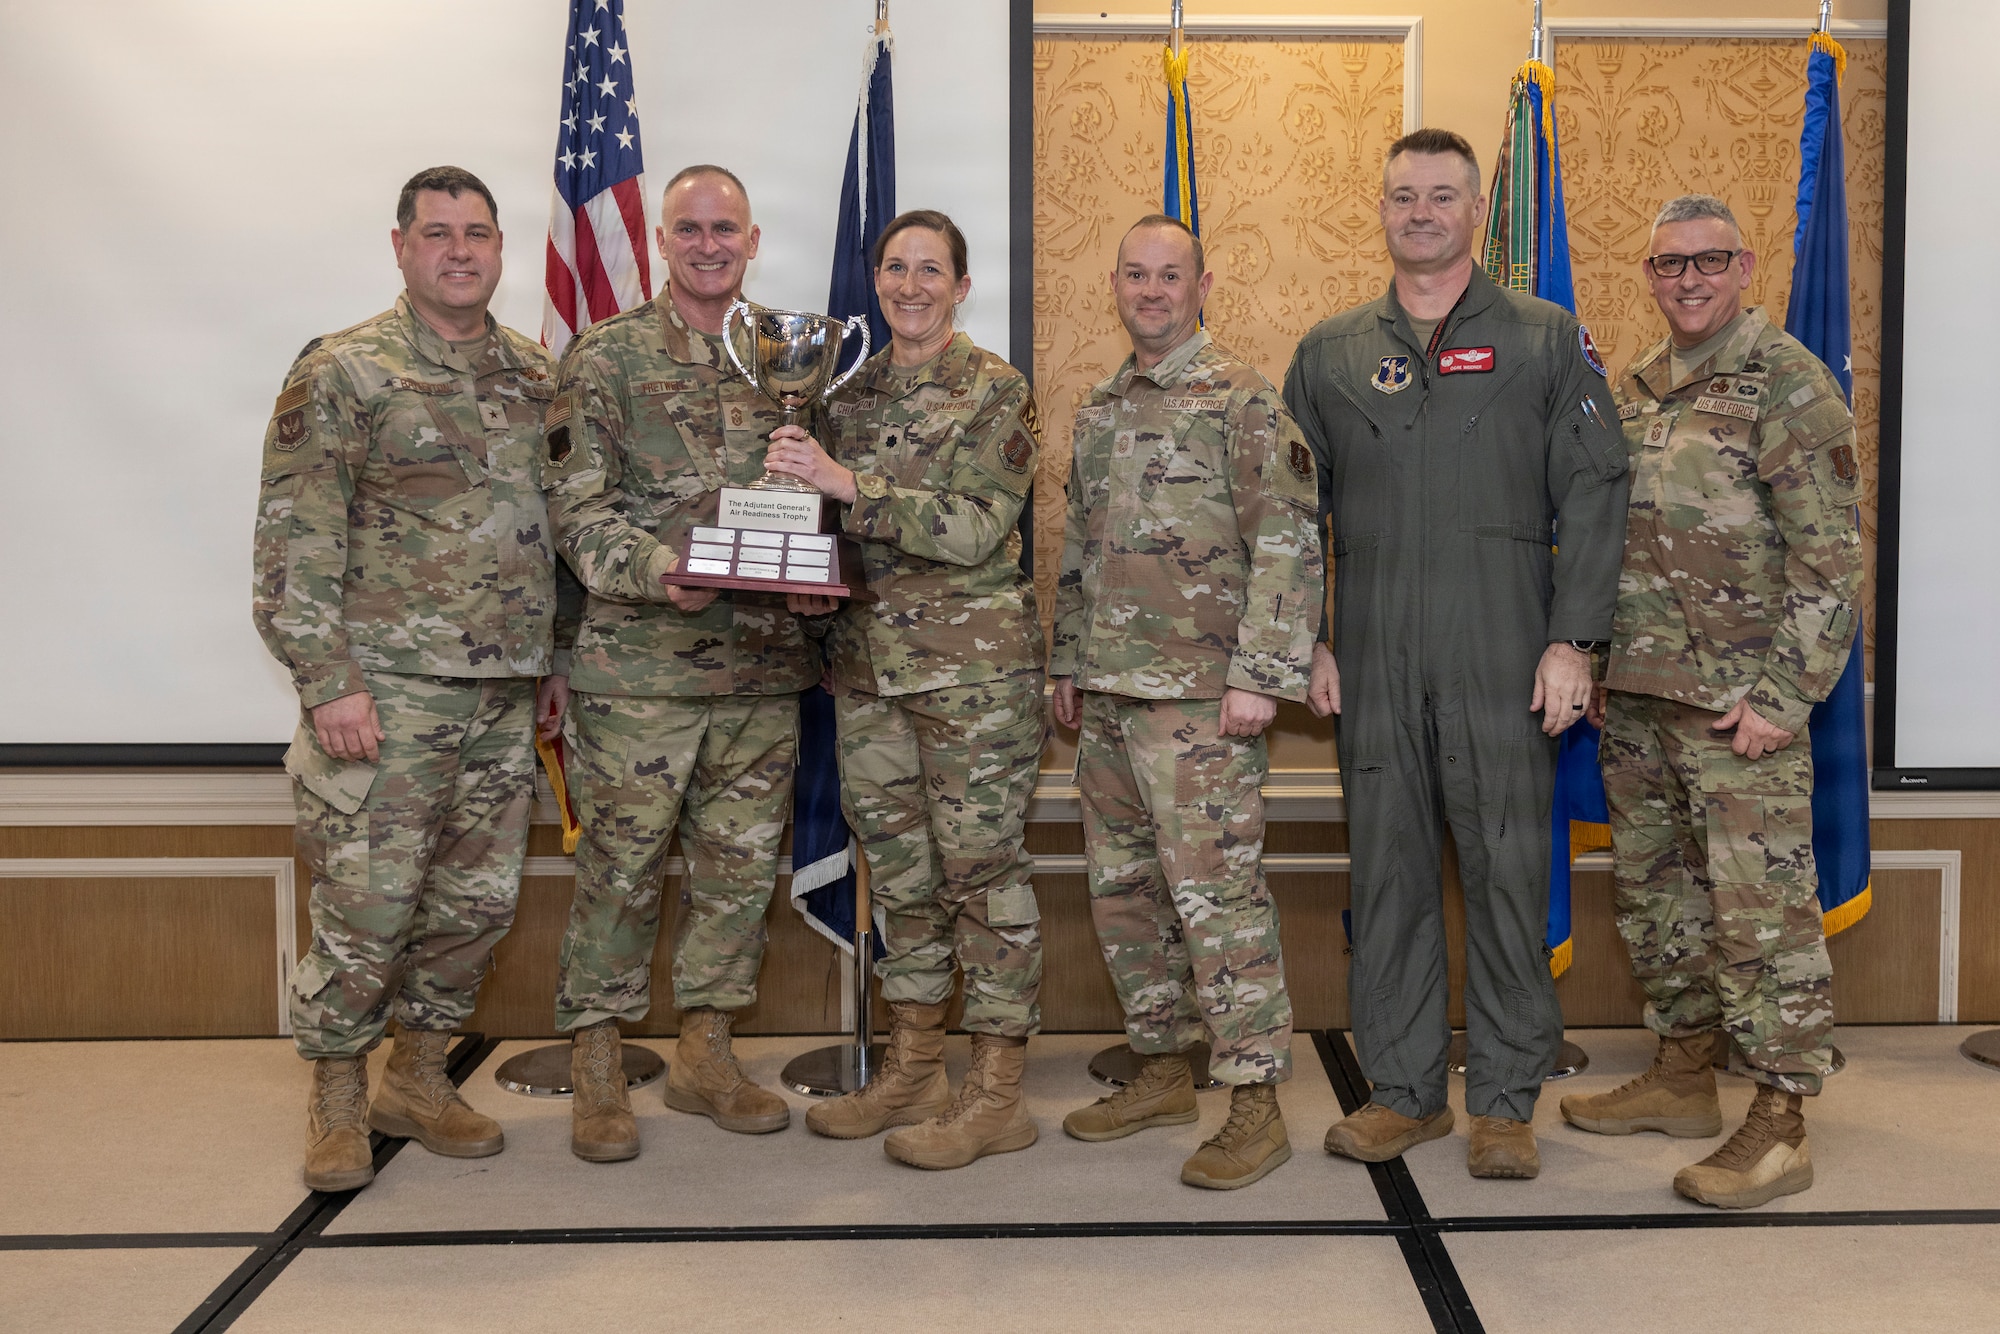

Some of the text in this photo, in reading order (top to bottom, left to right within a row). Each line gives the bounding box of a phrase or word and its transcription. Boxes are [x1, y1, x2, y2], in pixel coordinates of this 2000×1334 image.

[1178, 399, 1194, 409] AIR
[1194, 399, 1225, 410] FORCE
[1697, 398, 1756, 419] US AIR FORCE
[743, 501, 775, 510] Adjutant
[776, 503, 811, 512] General's
[742, 510, 780, 519] Readiness
[782, 512, 809, 521] Trophy
